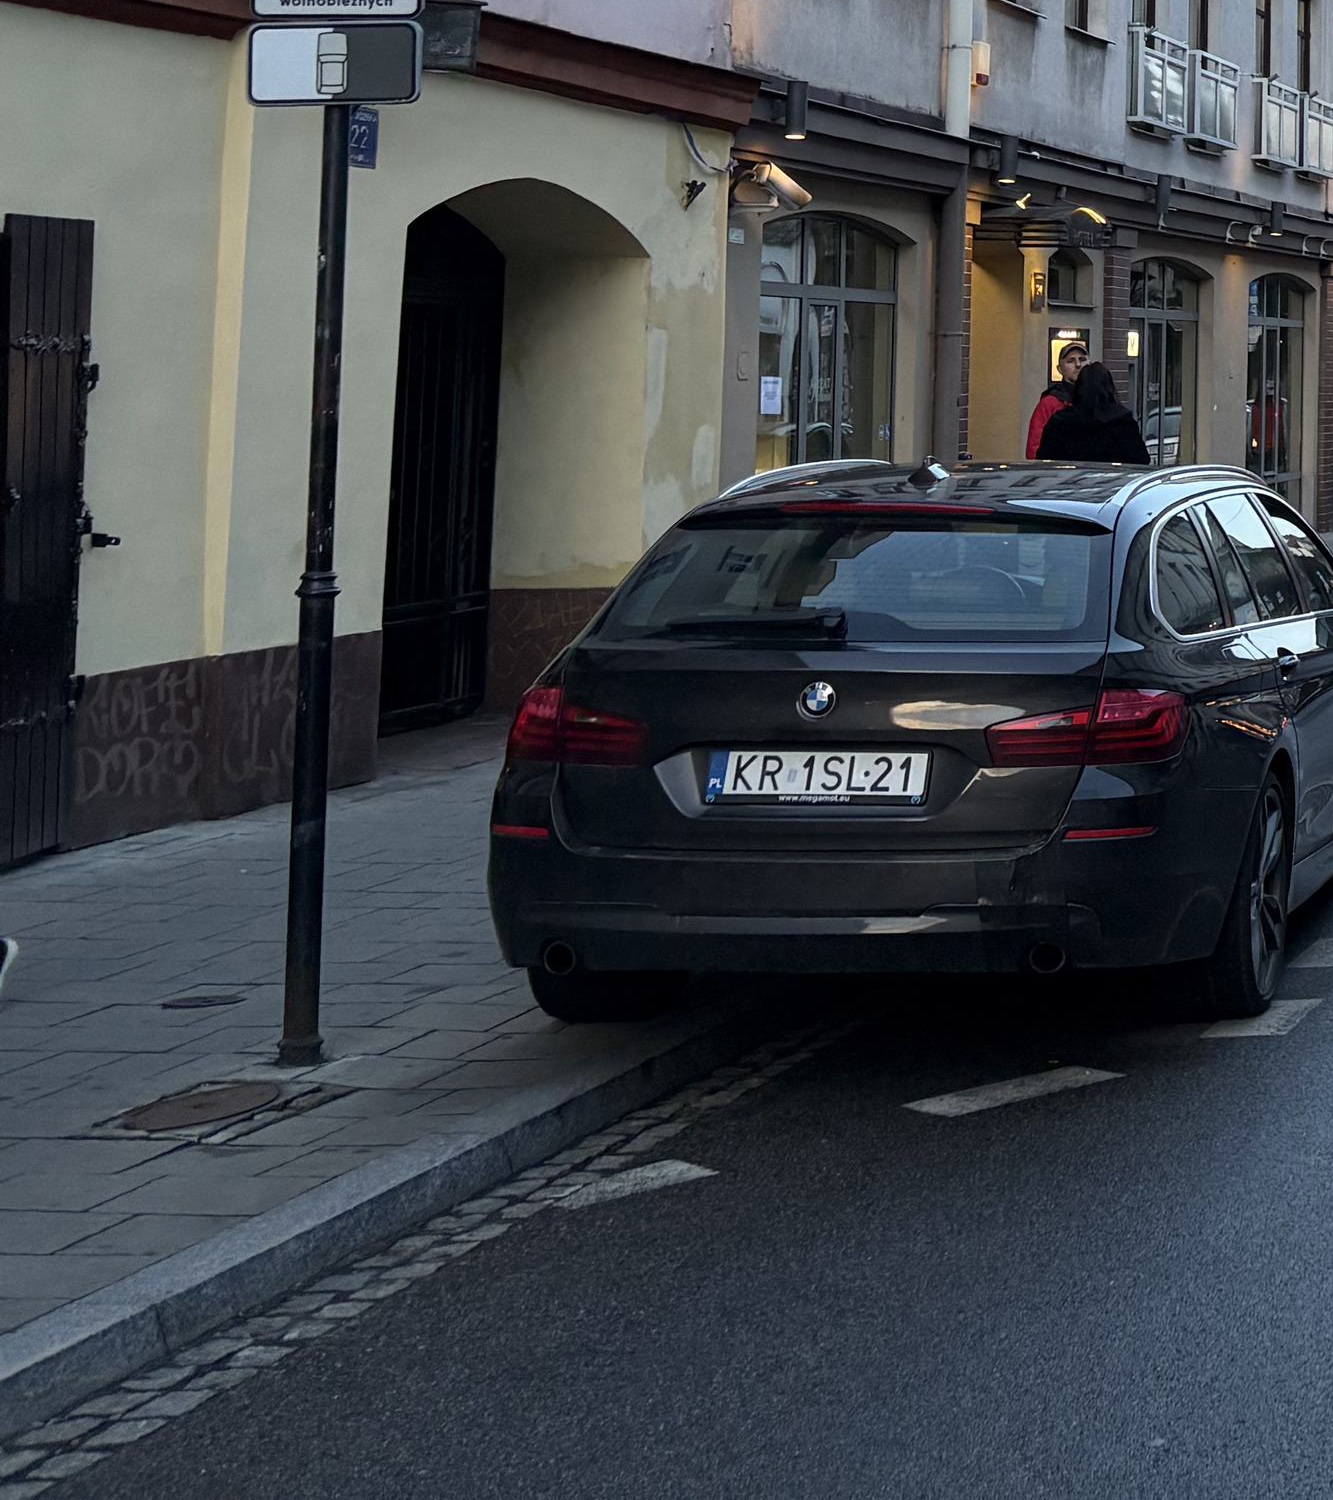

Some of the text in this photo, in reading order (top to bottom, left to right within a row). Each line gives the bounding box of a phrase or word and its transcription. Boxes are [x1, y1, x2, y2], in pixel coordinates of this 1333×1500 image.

[732, 755, 912, 792] KR 1SL21
[708, 777, 723, 788] PL
[778, 793, 851, 803] www.megamot.eu
